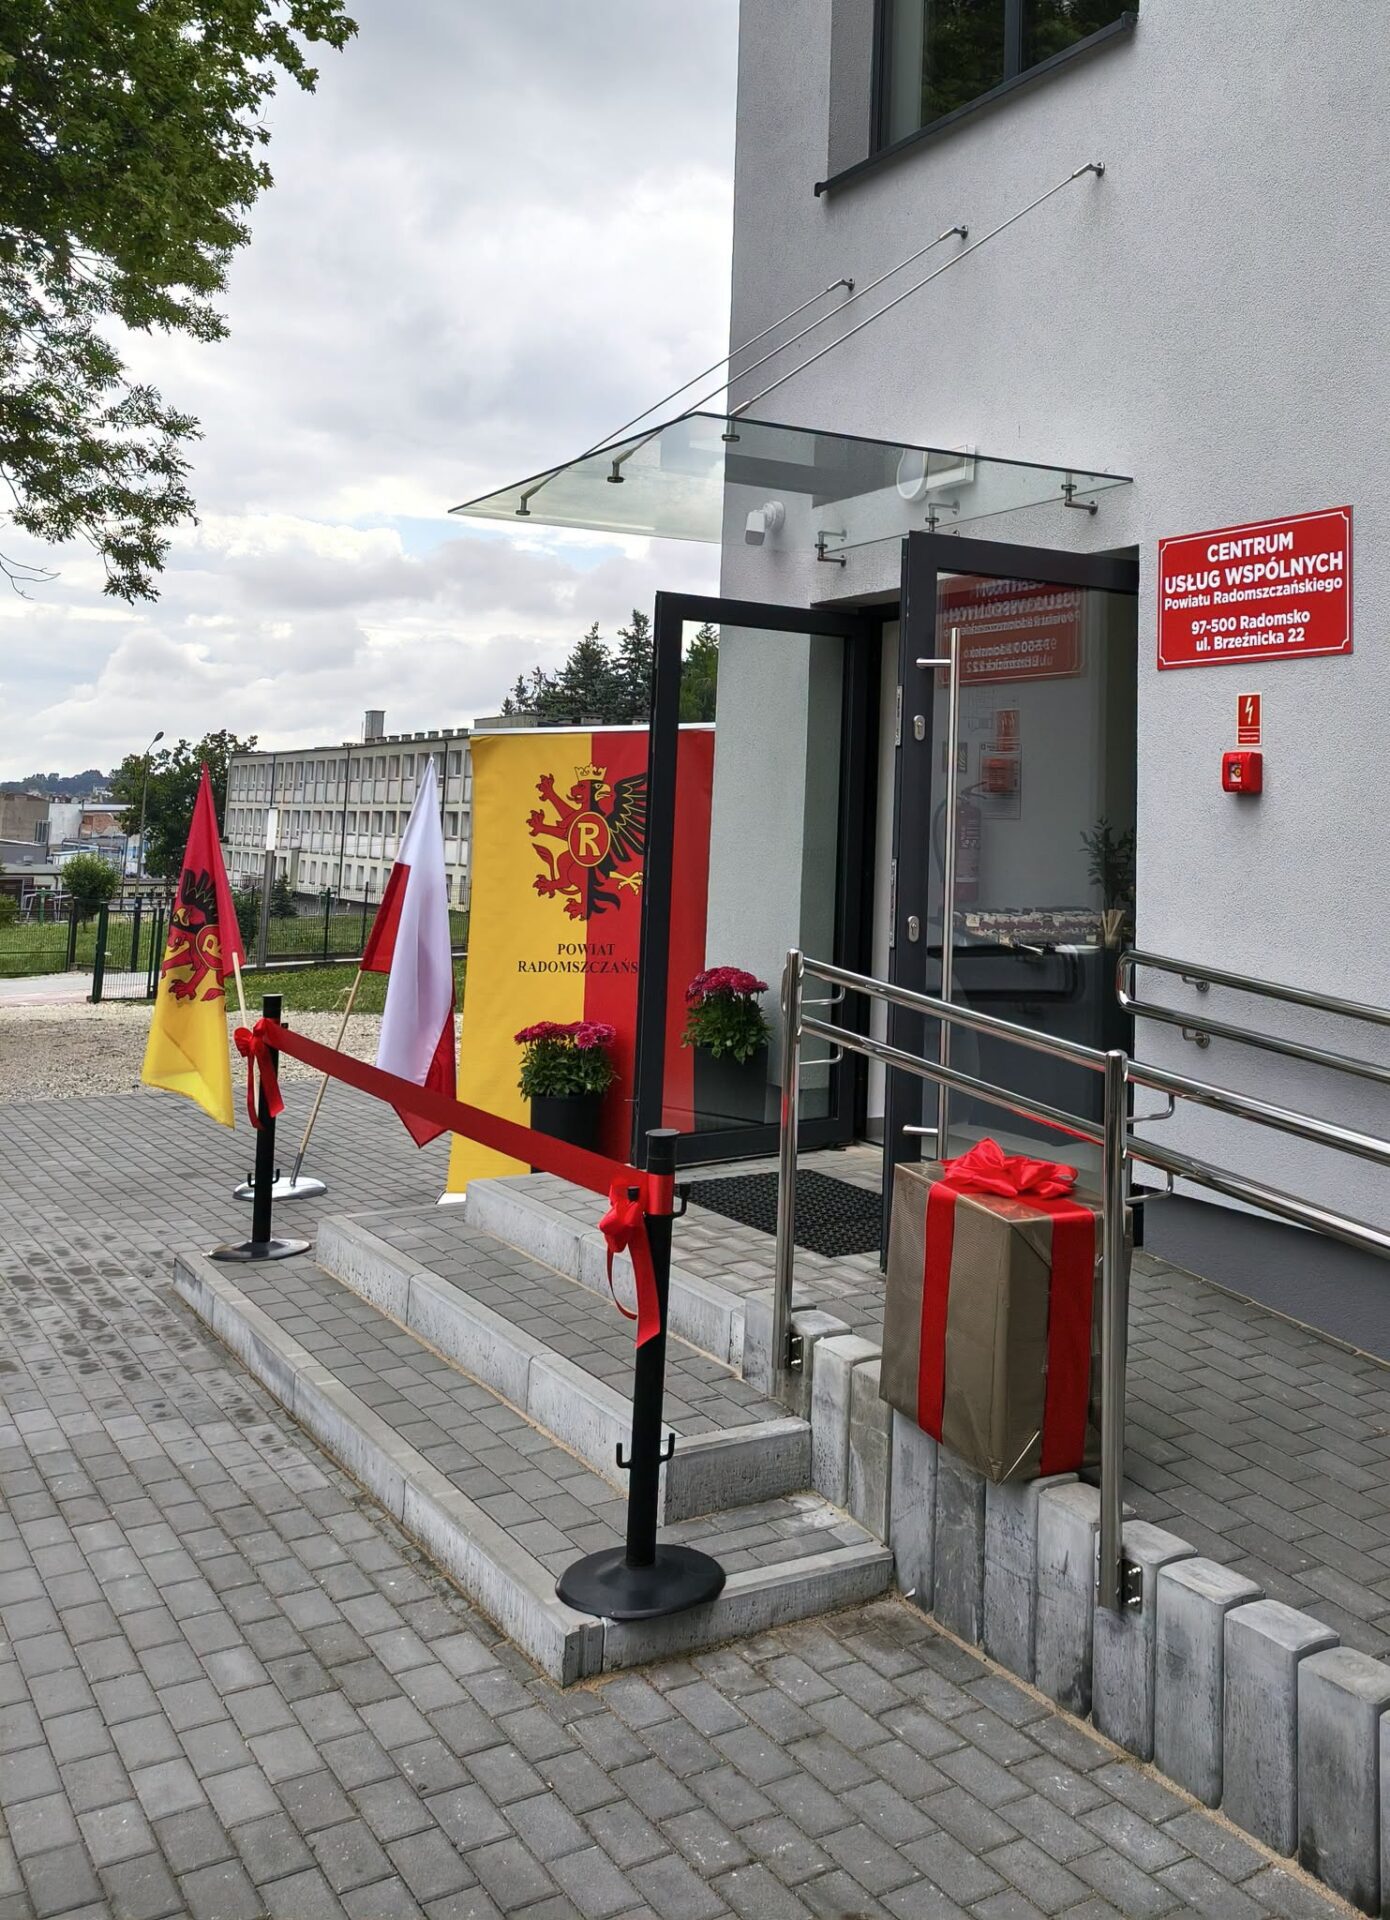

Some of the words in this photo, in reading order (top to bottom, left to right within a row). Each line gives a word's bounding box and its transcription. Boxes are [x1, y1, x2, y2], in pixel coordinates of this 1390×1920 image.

[1207, 531, 1294, 563] CENTRUM
[1164, 570, 1221, 594] USŁUG
[1224, 550, 1344, 586] WSPÓLNYCH
[1164, 593, 1211, 611] Powiatu
[1213, 576, 1343, 605] Radomszczańskiego
[1191, 617, 1237, 635] 97-500
[1240, 609, 1311, 630] Radomsko
[1196, 637, 1211, 652] ul.
[1214, 630, 1285, 650] Brzeźnicka
[1287, 627, 1305, 643] 22
[577, 822, 601, 857] R
[557, 943, 615, 956] POWIAT
[518, 957, 639, 974] RADOMSZCZAŃS
